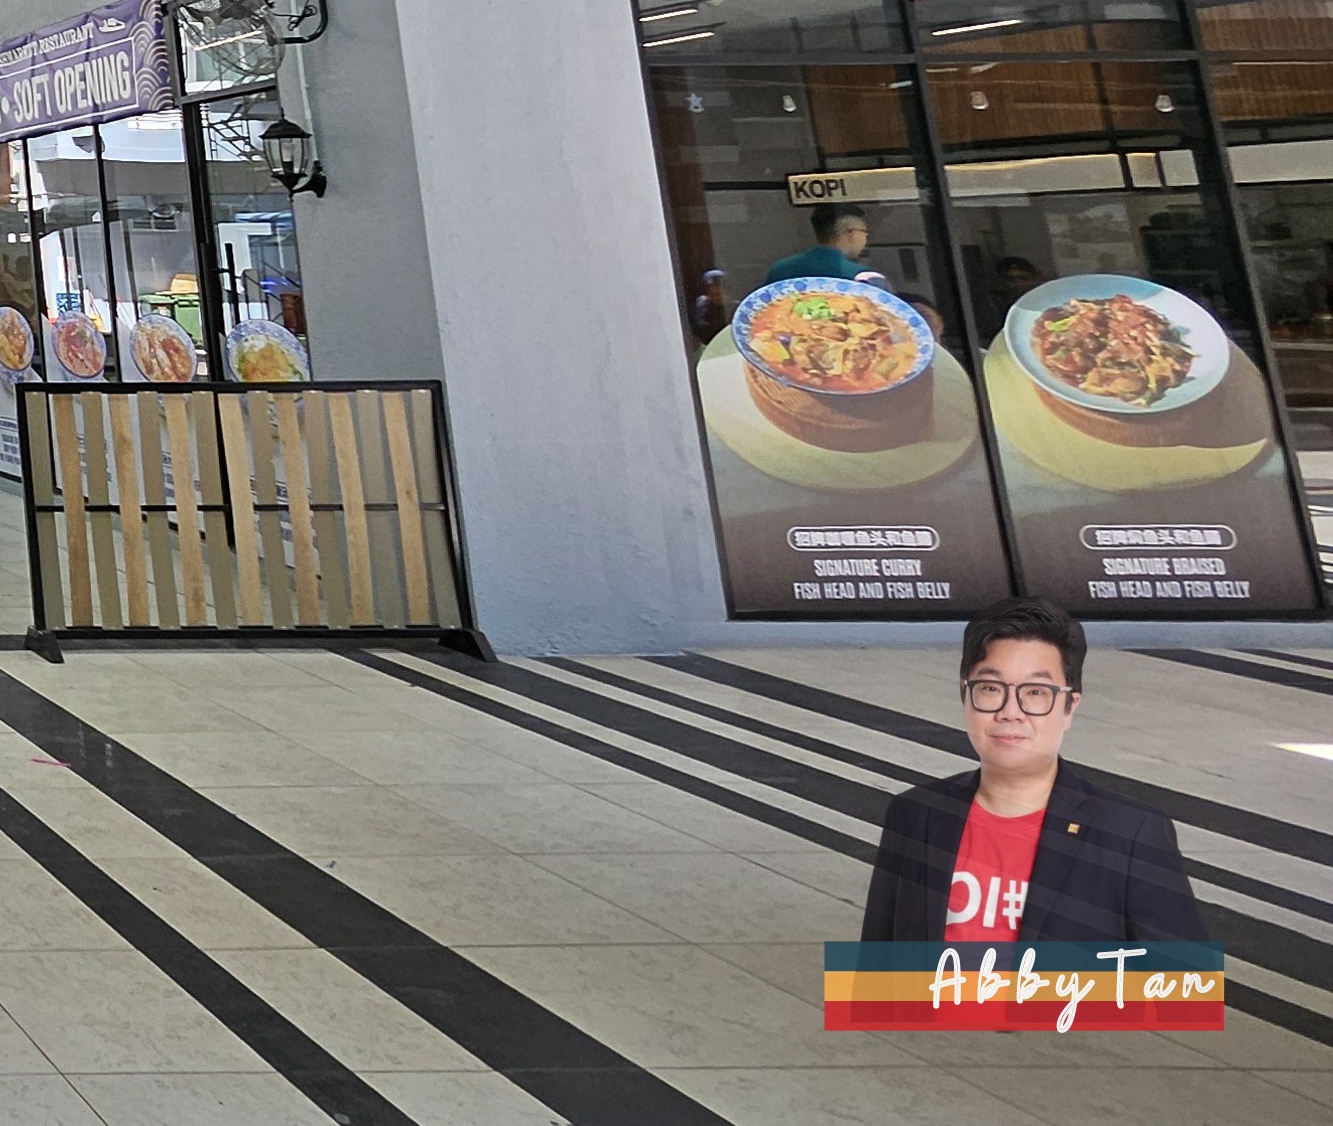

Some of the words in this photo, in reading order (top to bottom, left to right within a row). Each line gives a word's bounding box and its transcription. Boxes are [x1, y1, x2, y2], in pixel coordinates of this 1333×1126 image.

[39, 23, 95, 56] RESTAURANT
[13, 75, 53, 123] SOFT
[53, 50, 131, 114] OPENING
[793, 179, 847, 198] KOPI
[813, 559, 880, 577] SIGNATURE
[881, 559, 922, 576] CURRY
[1102, 558, 1172, 575] SIGNATURE
[1172, 558, 1226, 575] BRAISED
[793, 582, 821, 600] FISH
[823, 582, 855, 599] HEAD
[859, 582, 883, 599] AND
[885, 582, 914, 599] FISH
[916, 582, 950, 599] BELLY
[1088, 581, 1118, 598] FISH
[1119, 581, 1153, 598] HEAD
[1155, 581, 1182, 598] AND
[1183, 581, 1214, 598] FISH
[1213, 581, 1250, 598] BELLY
